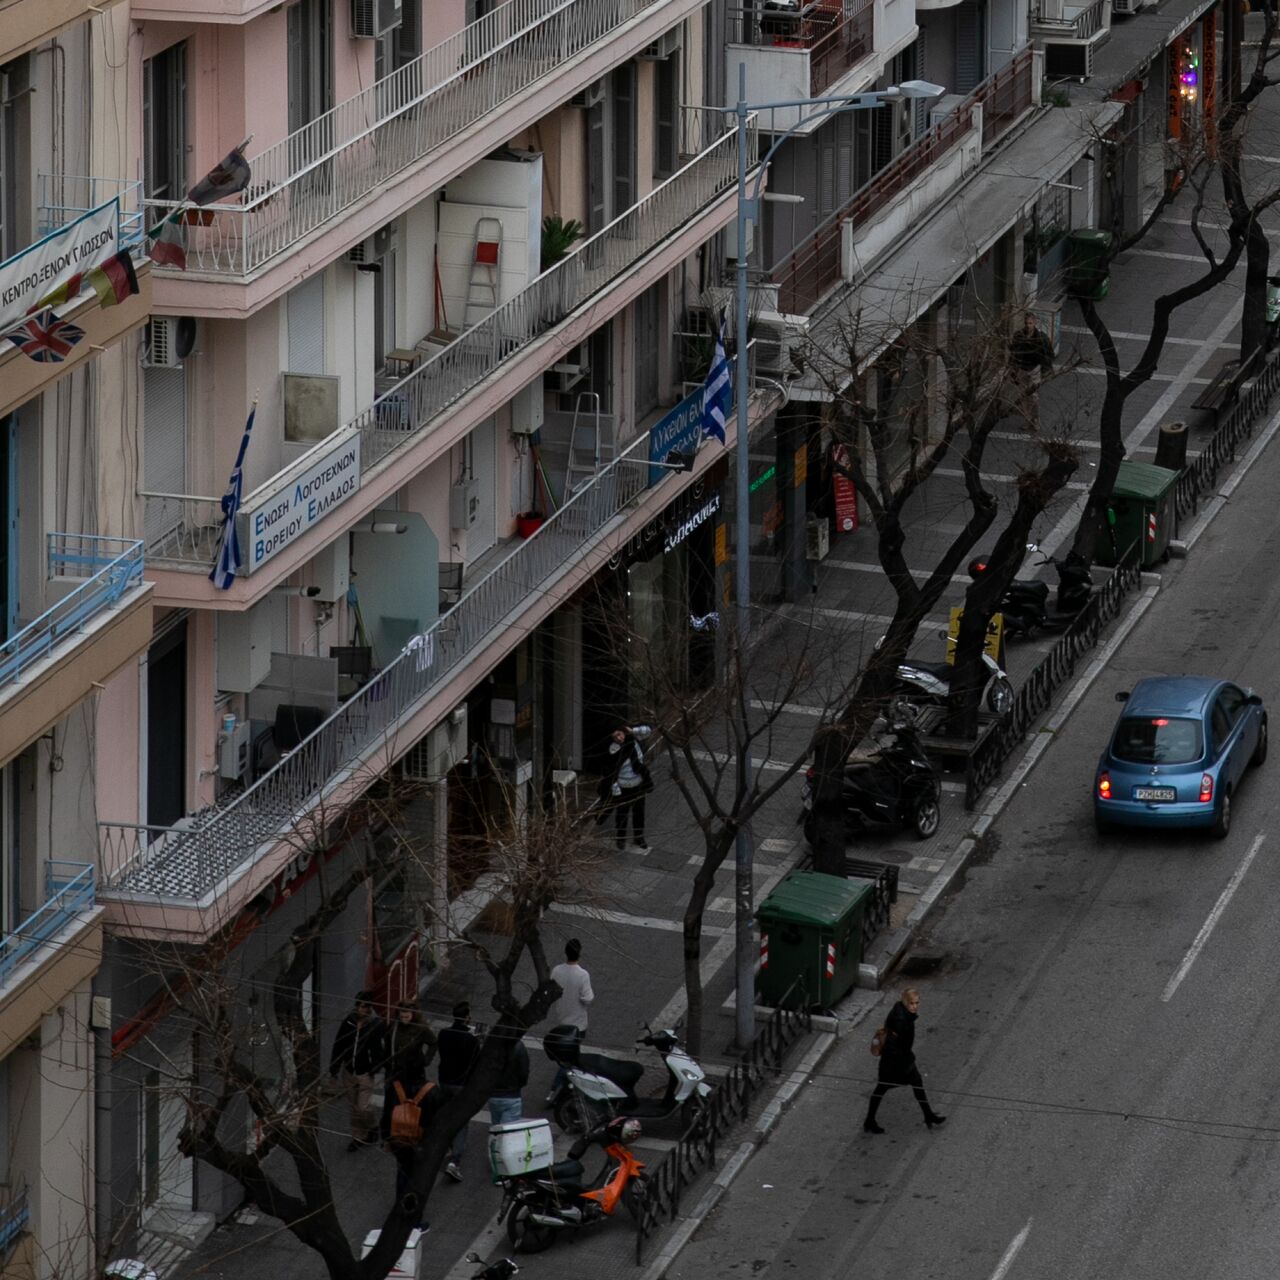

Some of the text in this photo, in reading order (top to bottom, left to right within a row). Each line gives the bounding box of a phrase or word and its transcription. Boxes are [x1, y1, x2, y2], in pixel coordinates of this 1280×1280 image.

[2, 226, 114, 307] ΚΕΝΤΡΟ ΞΕΝΩΝ ΓΛΩΣΣΩΝ
[255, 450, 355, 536] ΕΝΩΣΗ ΛΟΓΟΤΕΧΝΩΝ
[255, 475, 355, 563] ΒΟΡΕΙΟΥ ΕΛΛΑΔΟΣ
